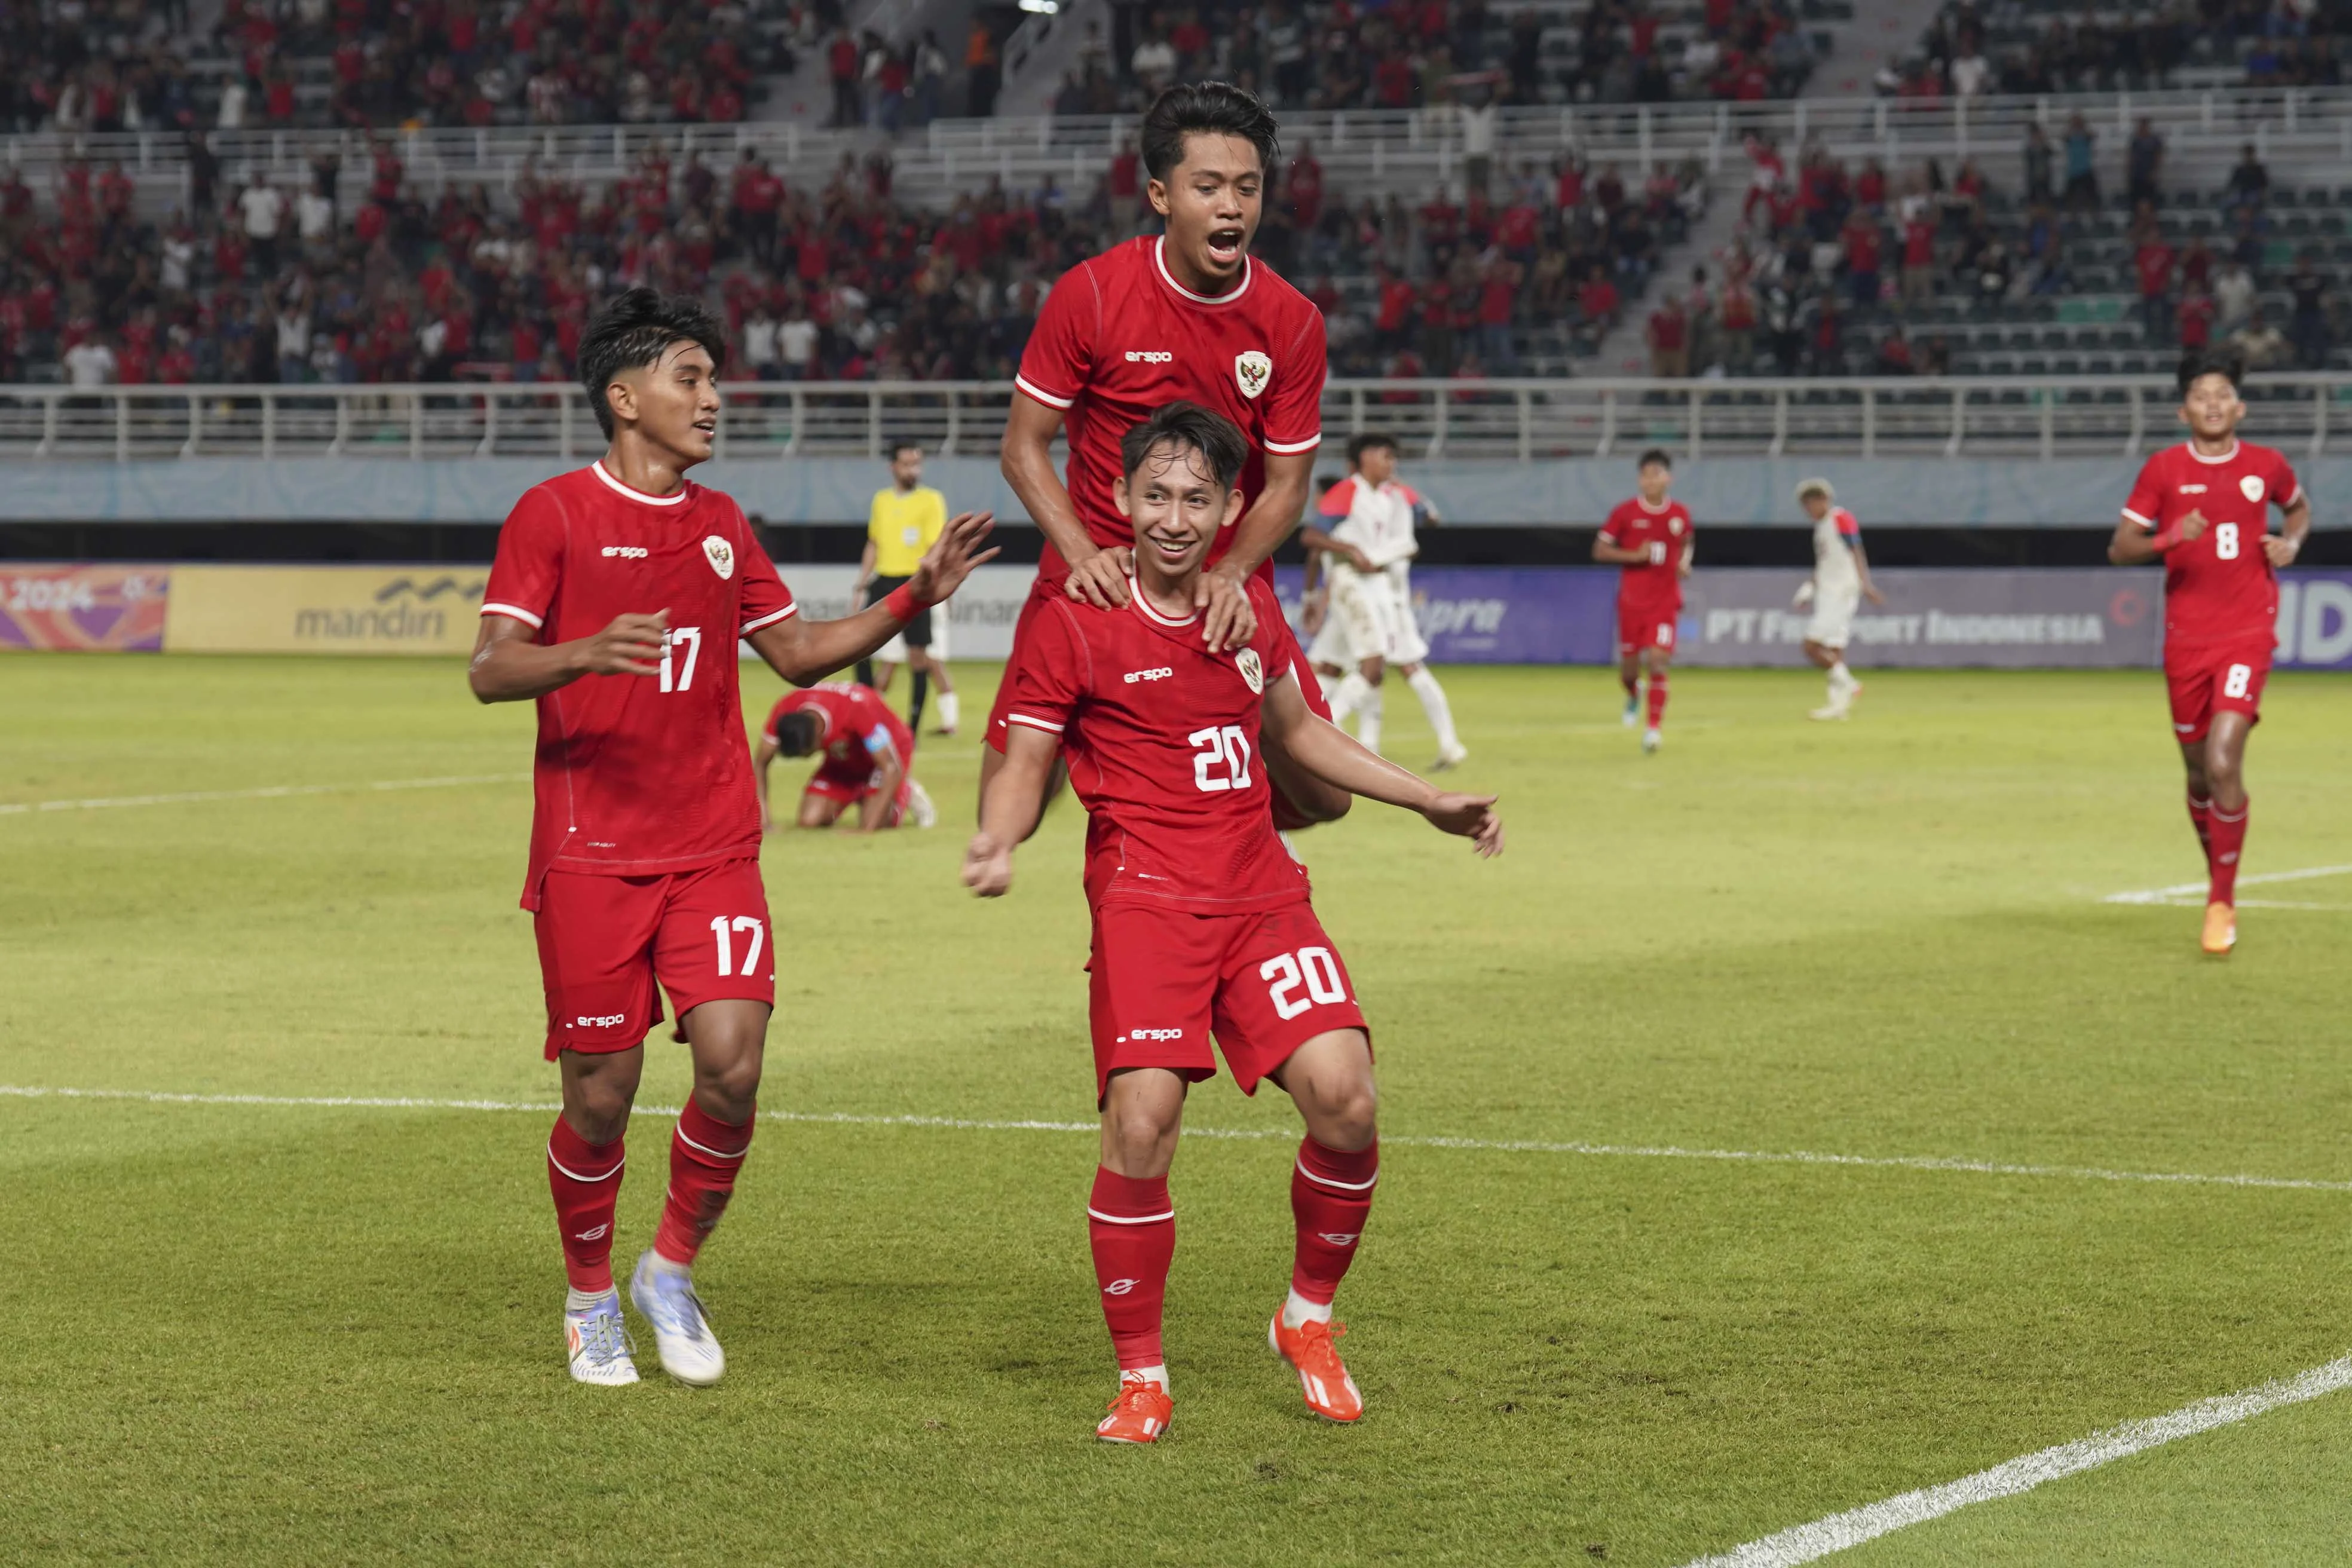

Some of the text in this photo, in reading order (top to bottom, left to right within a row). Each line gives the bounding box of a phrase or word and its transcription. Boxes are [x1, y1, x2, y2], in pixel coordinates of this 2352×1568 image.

[1125, 351, 1172, 364] erspo
[602, 547, 648, 559] erspo
[2216, 522, 2238, 559] 8
[10, 580, 94, 611] 2024
[295, 599, 444, 638] mandiri
[1706, 610, 1757, 643] PT
[659, 627, 701, 693] 17
[1124, 667, 1172, 683] erspo
[2224, 664, 2251, 699] 8
[1188, 725, 1251, 792] 20
[710, 915, 764, 976] 17
[1260, 947, 1346, 1020] 20
[578, 1013, 624, 1028] erspo
[1131, 1028, 1182, 1042] erspo
